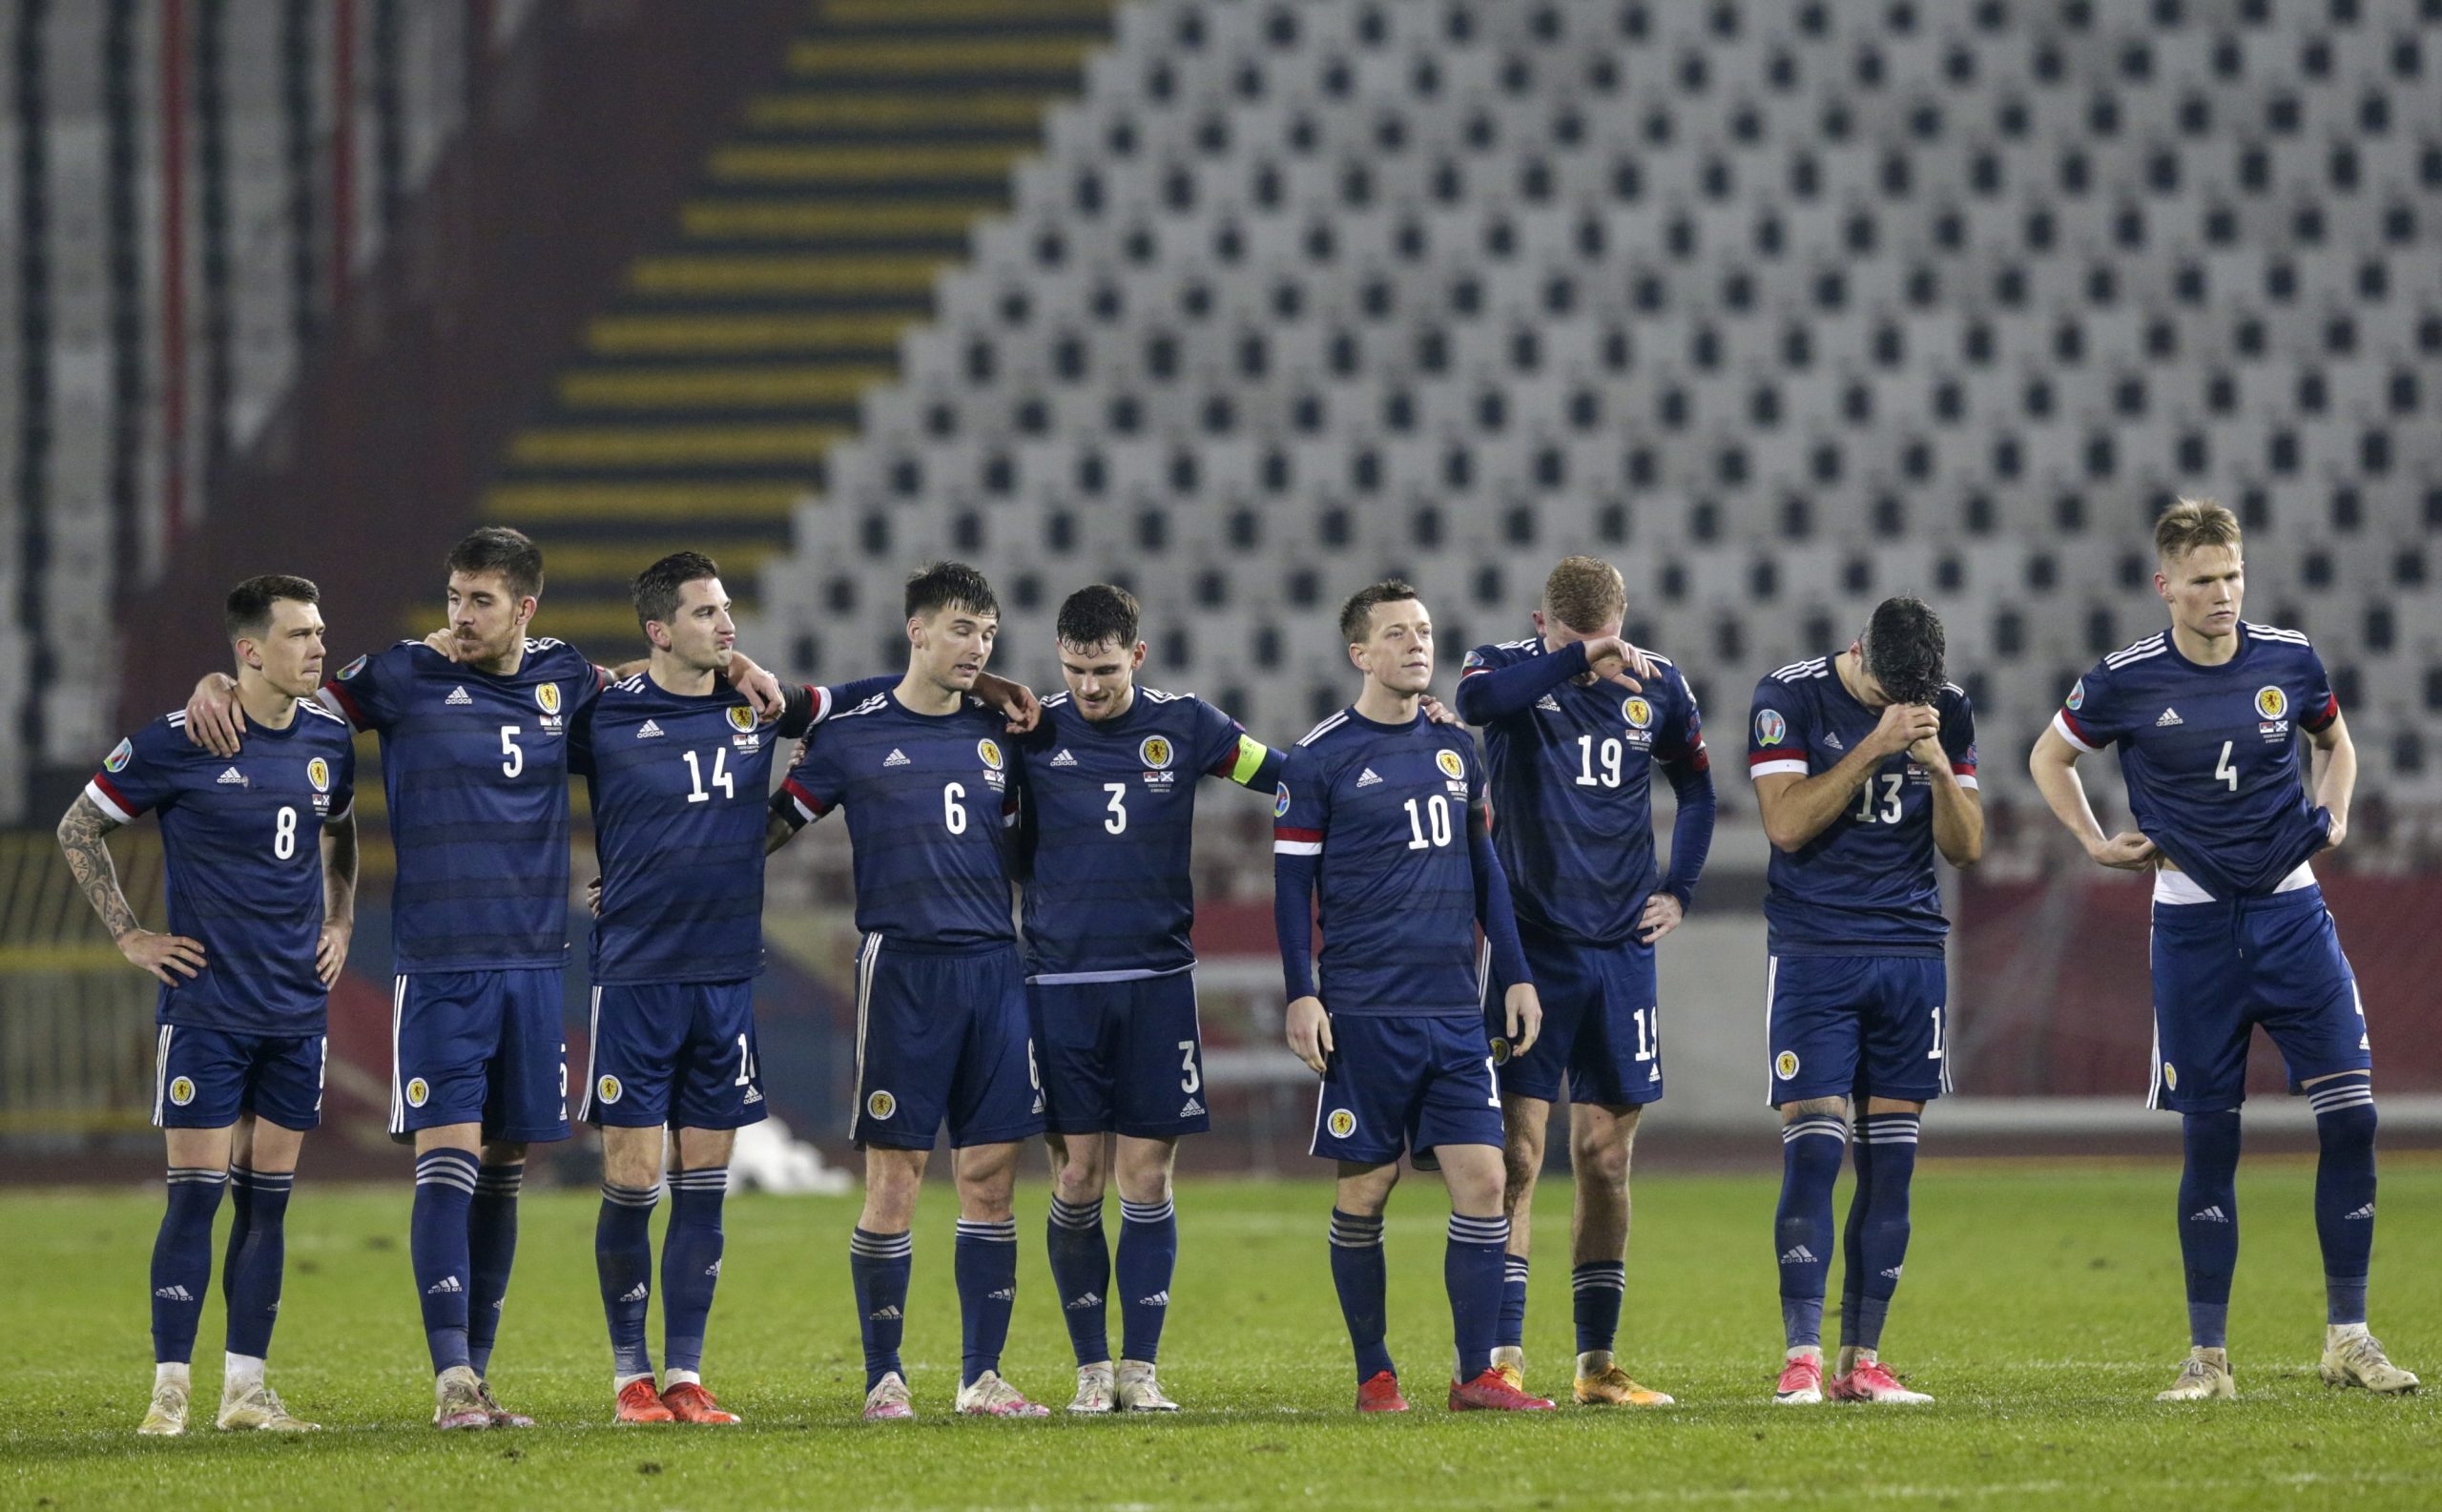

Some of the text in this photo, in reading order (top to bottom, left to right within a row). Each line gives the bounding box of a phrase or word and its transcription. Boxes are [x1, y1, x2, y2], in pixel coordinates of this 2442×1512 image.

[1536, 702, 1560, 711] adidas
[501, 725, 524, 778] 5
[683, 747, 734, 802] 14
[1576, 735, 1623, 788] 19
[2215, 740, 2238, 792] 4
[944, 781, 967, 835] 6
[1104, 782, 1128, 835] 3
[1356, 777, 1382, 787] adidas
[1856, 774, 1903, 824] 13
[274, 806, 297, 860] 8
[1404, 795, 1452, 850] 10
[1633, 1006, 1657, 1062] 19
[1928, 1006, 1942, 1060] 1
[1028, 1037, 1040, 1090] 6
[1179, 1040, 1200, 1094] 3
[1485, 1055, 1502, 1108] 1
[743, 1093, 762, 1104] adidas
[1180, 1108, 1205, 1117] adidas
[155, 1291, 193, 1301] adidas
